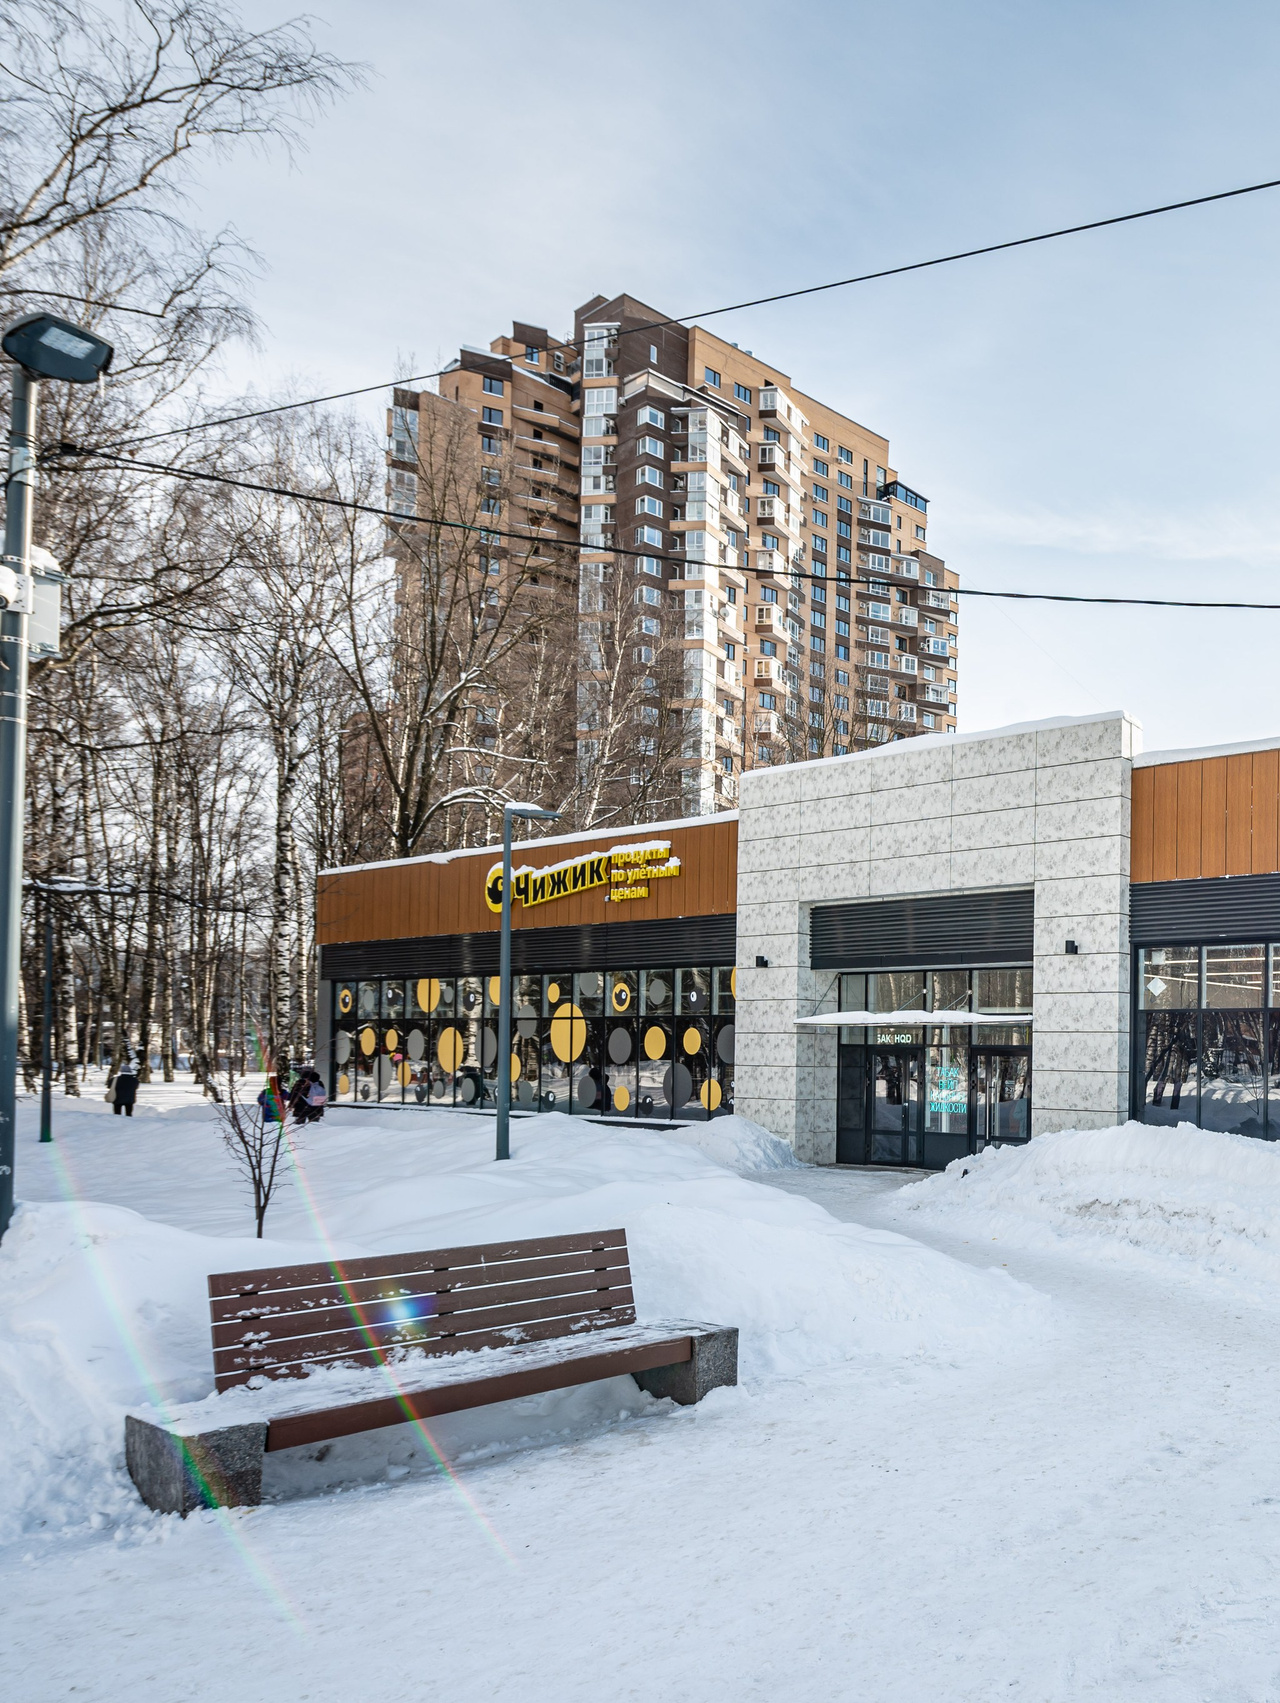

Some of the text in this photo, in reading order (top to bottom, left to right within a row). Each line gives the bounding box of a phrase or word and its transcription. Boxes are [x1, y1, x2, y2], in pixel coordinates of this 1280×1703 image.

[611, 848, 670, 866] продукты
[611, 863, 680, 884] по улётным
[611, 887, 649, 902] ценам
[894, 1034, 912, 1043] HQD
[935, 1066, 960, 1078] ТАБАК
[938, 1078, 959, 1090] ВЕЙП
[929, 1101, 967, 1114] ЖИДКОСТИ
